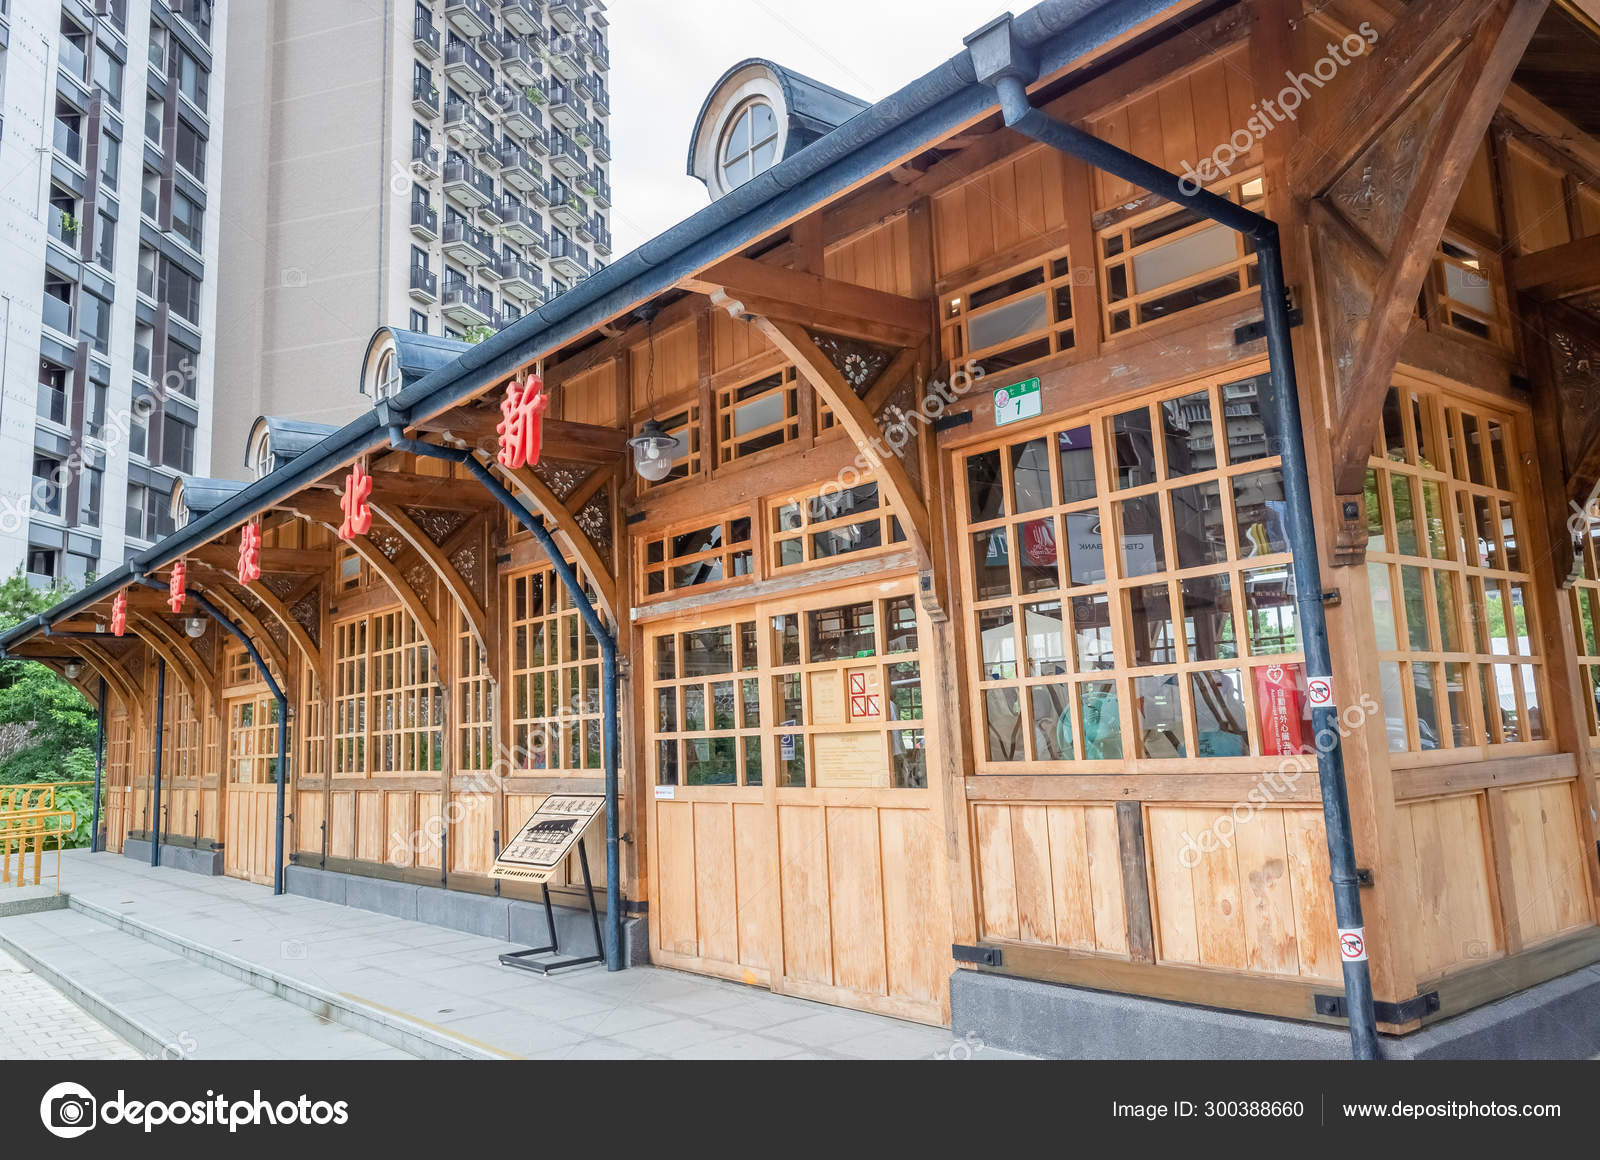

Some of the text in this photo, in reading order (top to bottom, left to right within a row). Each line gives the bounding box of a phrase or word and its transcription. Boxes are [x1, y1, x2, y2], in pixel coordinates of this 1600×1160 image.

[496, 374, 548, 469] 新
[1015, 399, 1021, 415] 1
[338, 462, 372, 539] 北
